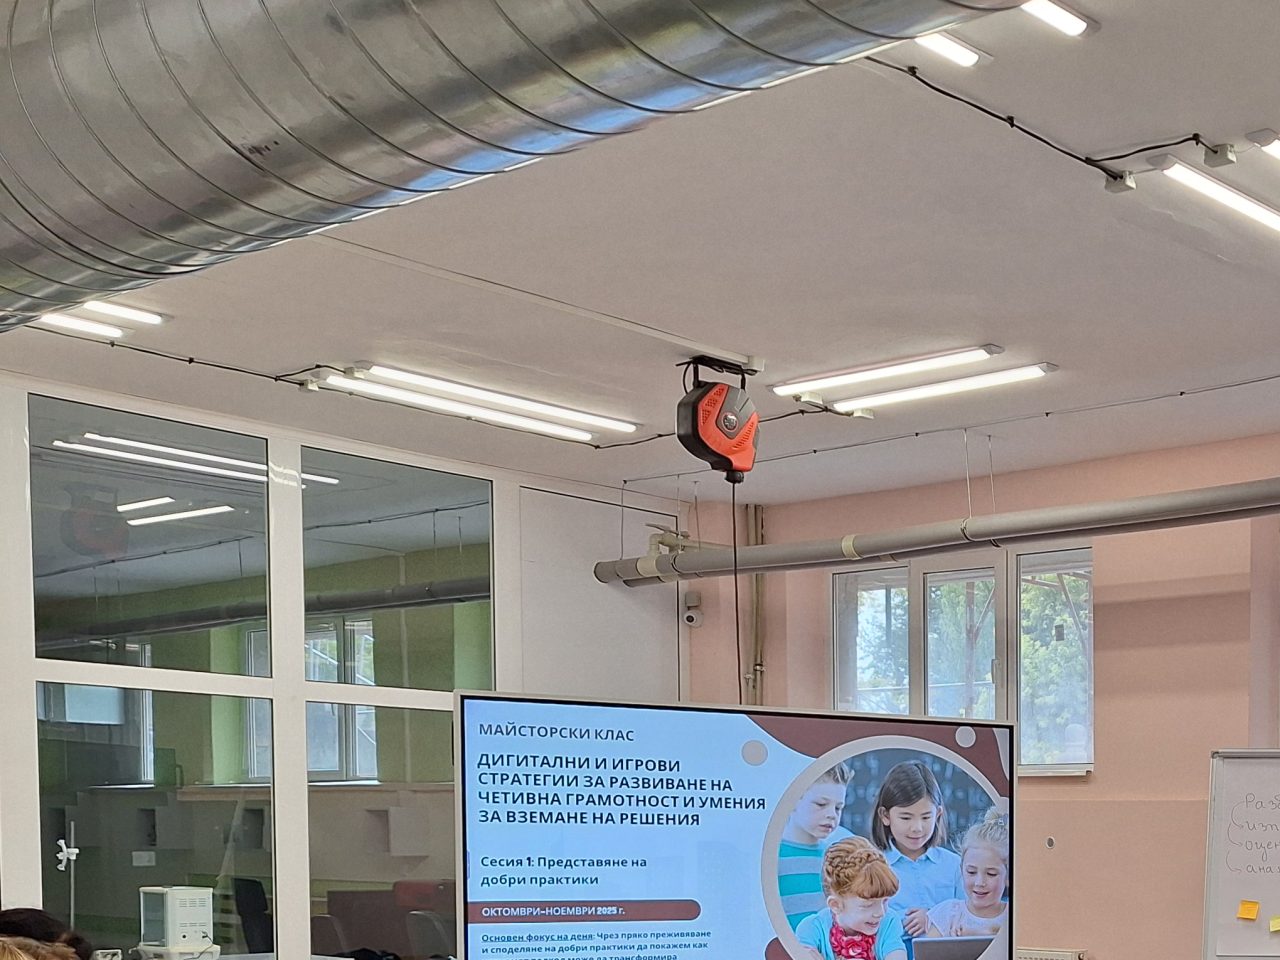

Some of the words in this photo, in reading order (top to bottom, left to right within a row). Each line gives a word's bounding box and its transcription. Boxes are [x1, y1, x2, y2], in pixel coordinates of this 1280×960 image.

[480, 721, 590, 739] МАЙСТОРСКИ
[594, 728, 634, 741] КЛАС
[477, 753, 590, 769] ДИГИТАЛНИ
[595, 757, 607, 769] И
[612, 758, 680, 772] ИГРОВИ
[478, 772, 579, 787] СТРАТЕГИИ
[583, 775, 605, 788] ЗА
[609, 776, 707, 791] РАЗВИВАНЕ
[711, 779, 733, 792] НА
[478, 791, 562, 805] ЧЕТИВНА
[566, 793, 680, 808] ГРАМОТНОСТ
[683, 796, 695, 808] И
[699, 796, 766, 810] УМЕНИЯ
[478, 809, 502, 823] ЗА
[506, 810, 588, 824] ВЗЕМАНЕ
[592, 812, 616, 825] НА
[620, 812, 700, 826] РЕШЕНИЯ
[481, 856, 523, 867] Сесия
[526, 856, 535, 867] 1:
[537, 856, 628, 870] Представяне
[631, 858, 647, 867] на
[480, 874, 526, 887] добри
[530, 875, 599, 887] практики
[596, 906, 618, 915] 2025
[481, 934, 524, 942] Основен
[526, 933, 554, 942] фокус
[570, 933, 595, 942] деня:
[597, 932, 619, 941] Чрез
[621, 932, 648, 941] пряко
[650, 931, 711, 940] преживяване
[491, 946, 543, 955] споделяне
[558, 944, 588, 953] добри
[590, 943, 635, 953] практики
[637, 943, 647, 951] да
[650, 942, 691, 950] покажем
